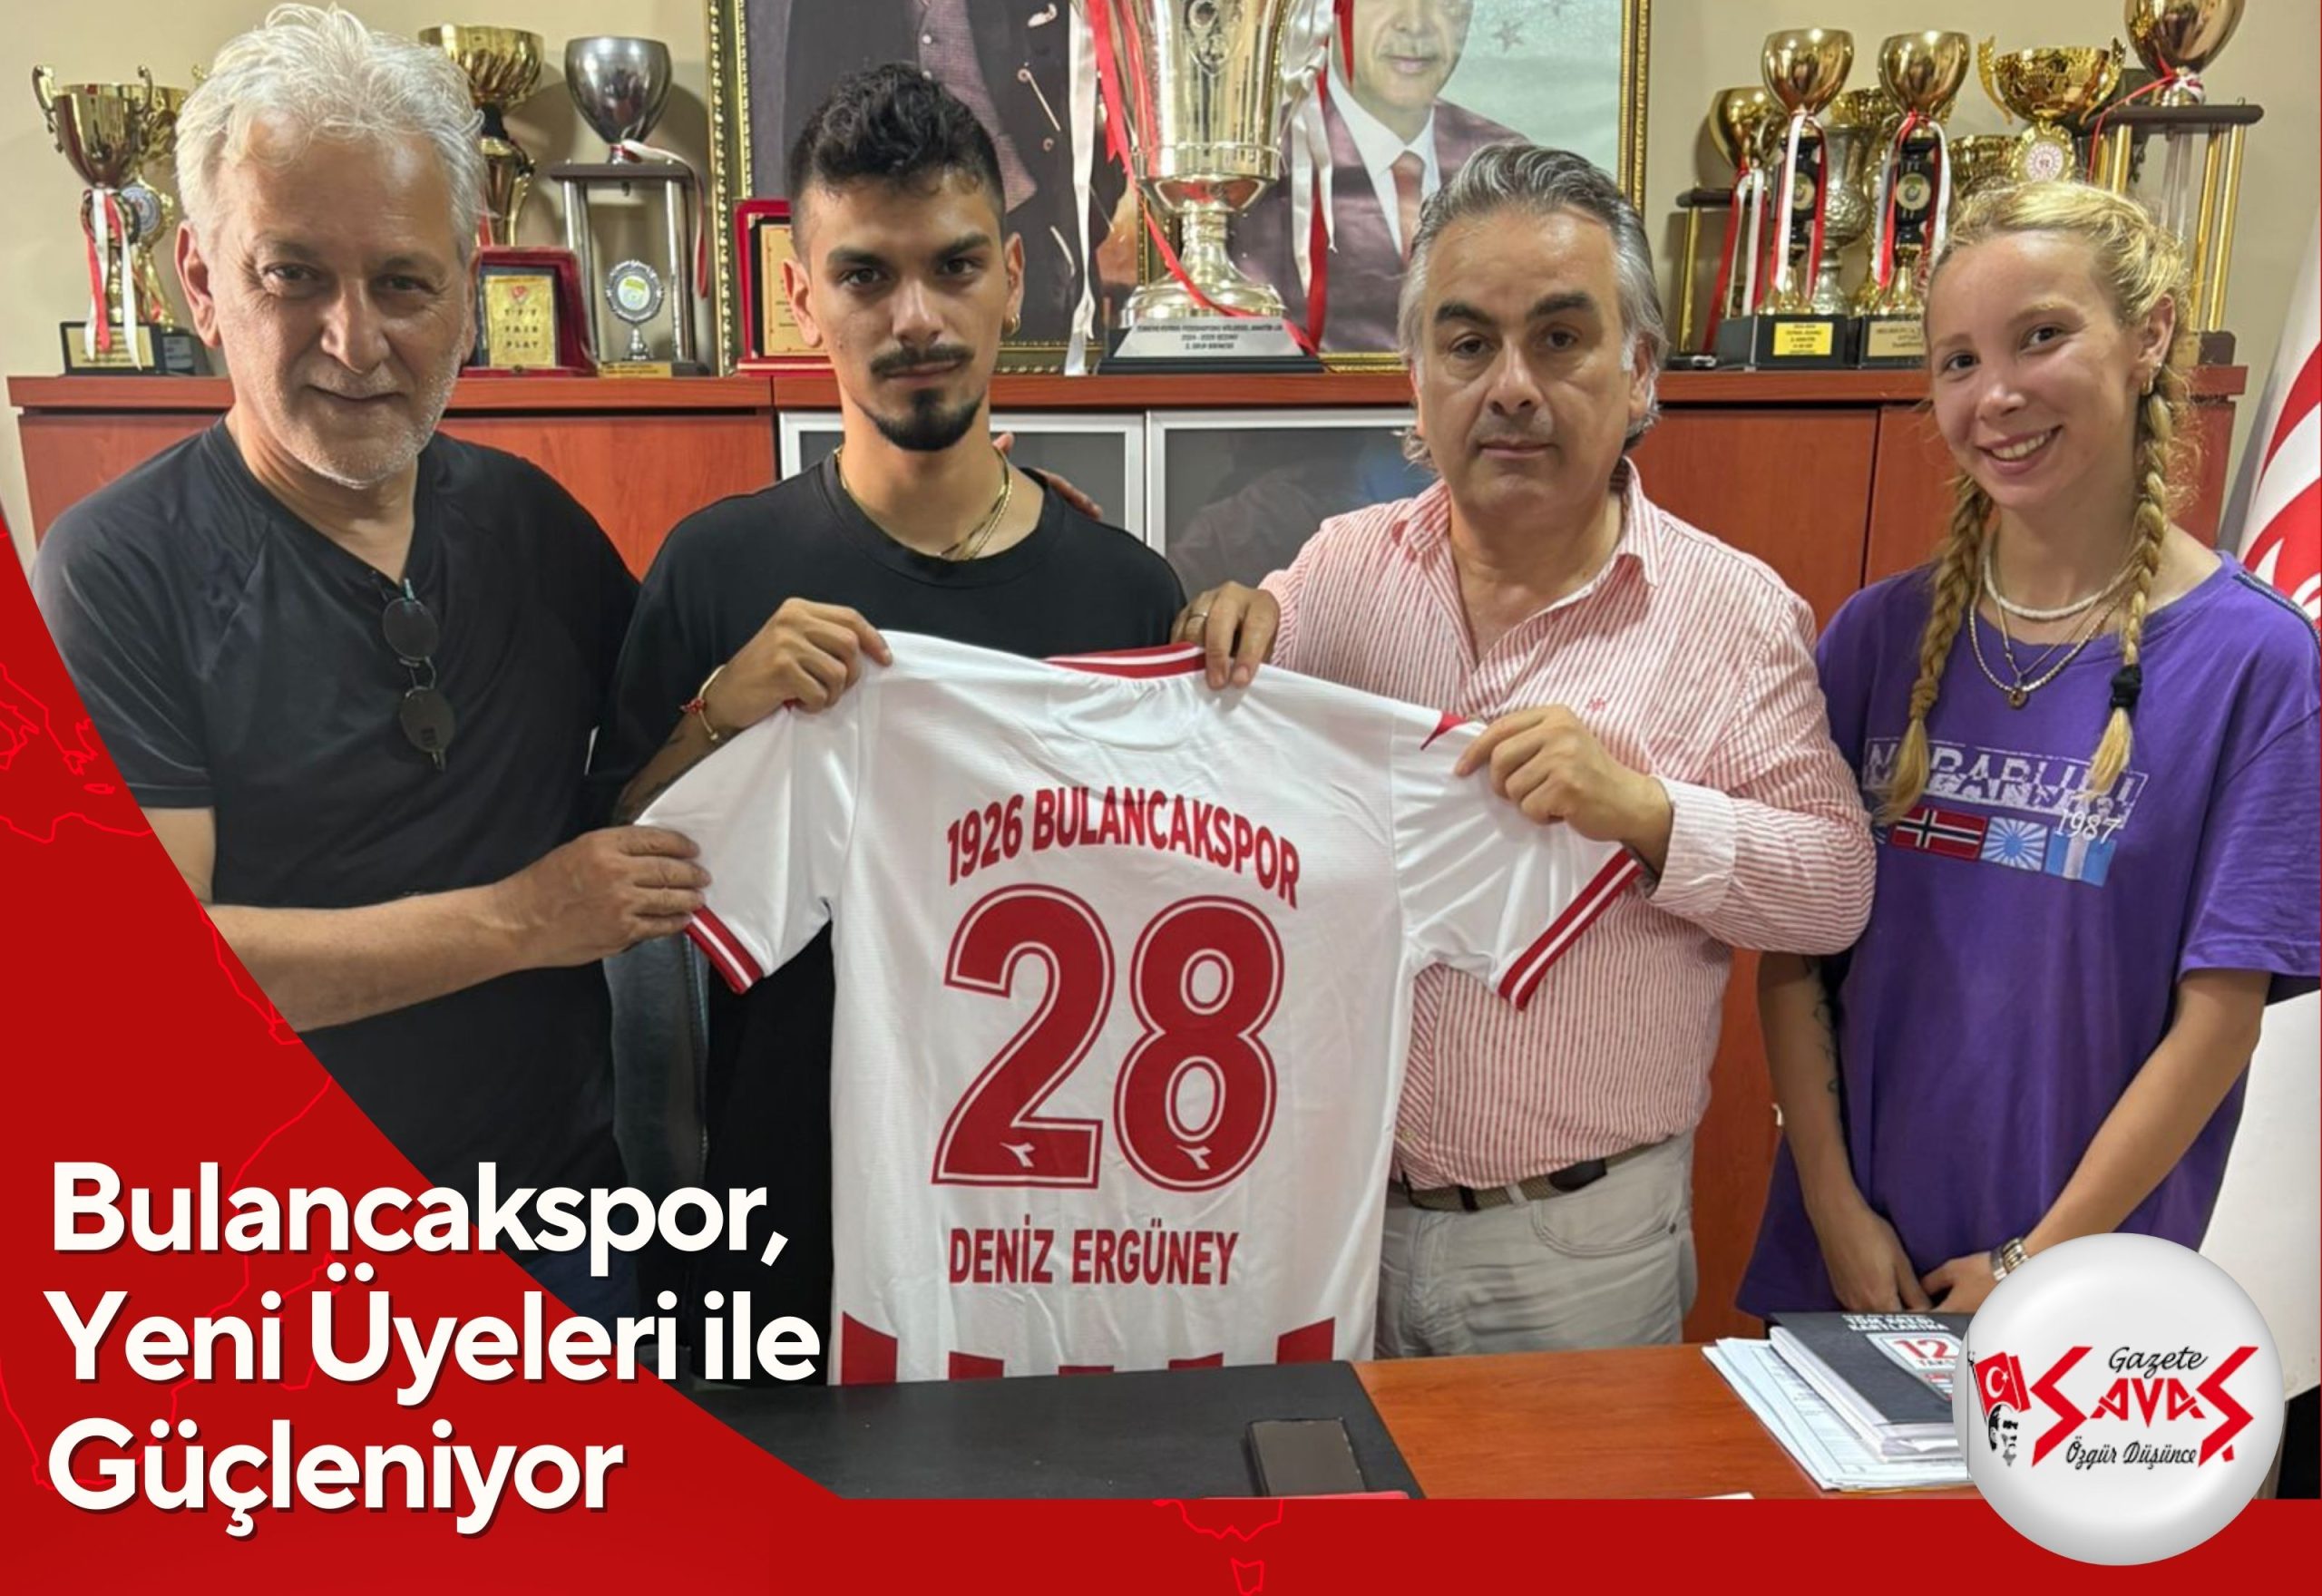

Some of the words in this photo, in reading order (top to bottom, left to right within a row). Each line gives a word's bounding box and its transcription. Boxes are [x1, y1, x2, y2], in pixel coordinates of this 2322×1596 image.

[947, 794, 1022, 887] 1926
[1031, 785, 1300, 910] BULANCAKSPOR
[2055, 808, 2123, 844] 1987
[932, 882, 1286, 1192] 28
[949, 1214, 1054, 1285] DENİZ
[1072, 1219, 1240, 1286] ERGÜNEY
[1894, 1339, 1959, 1358] 12
